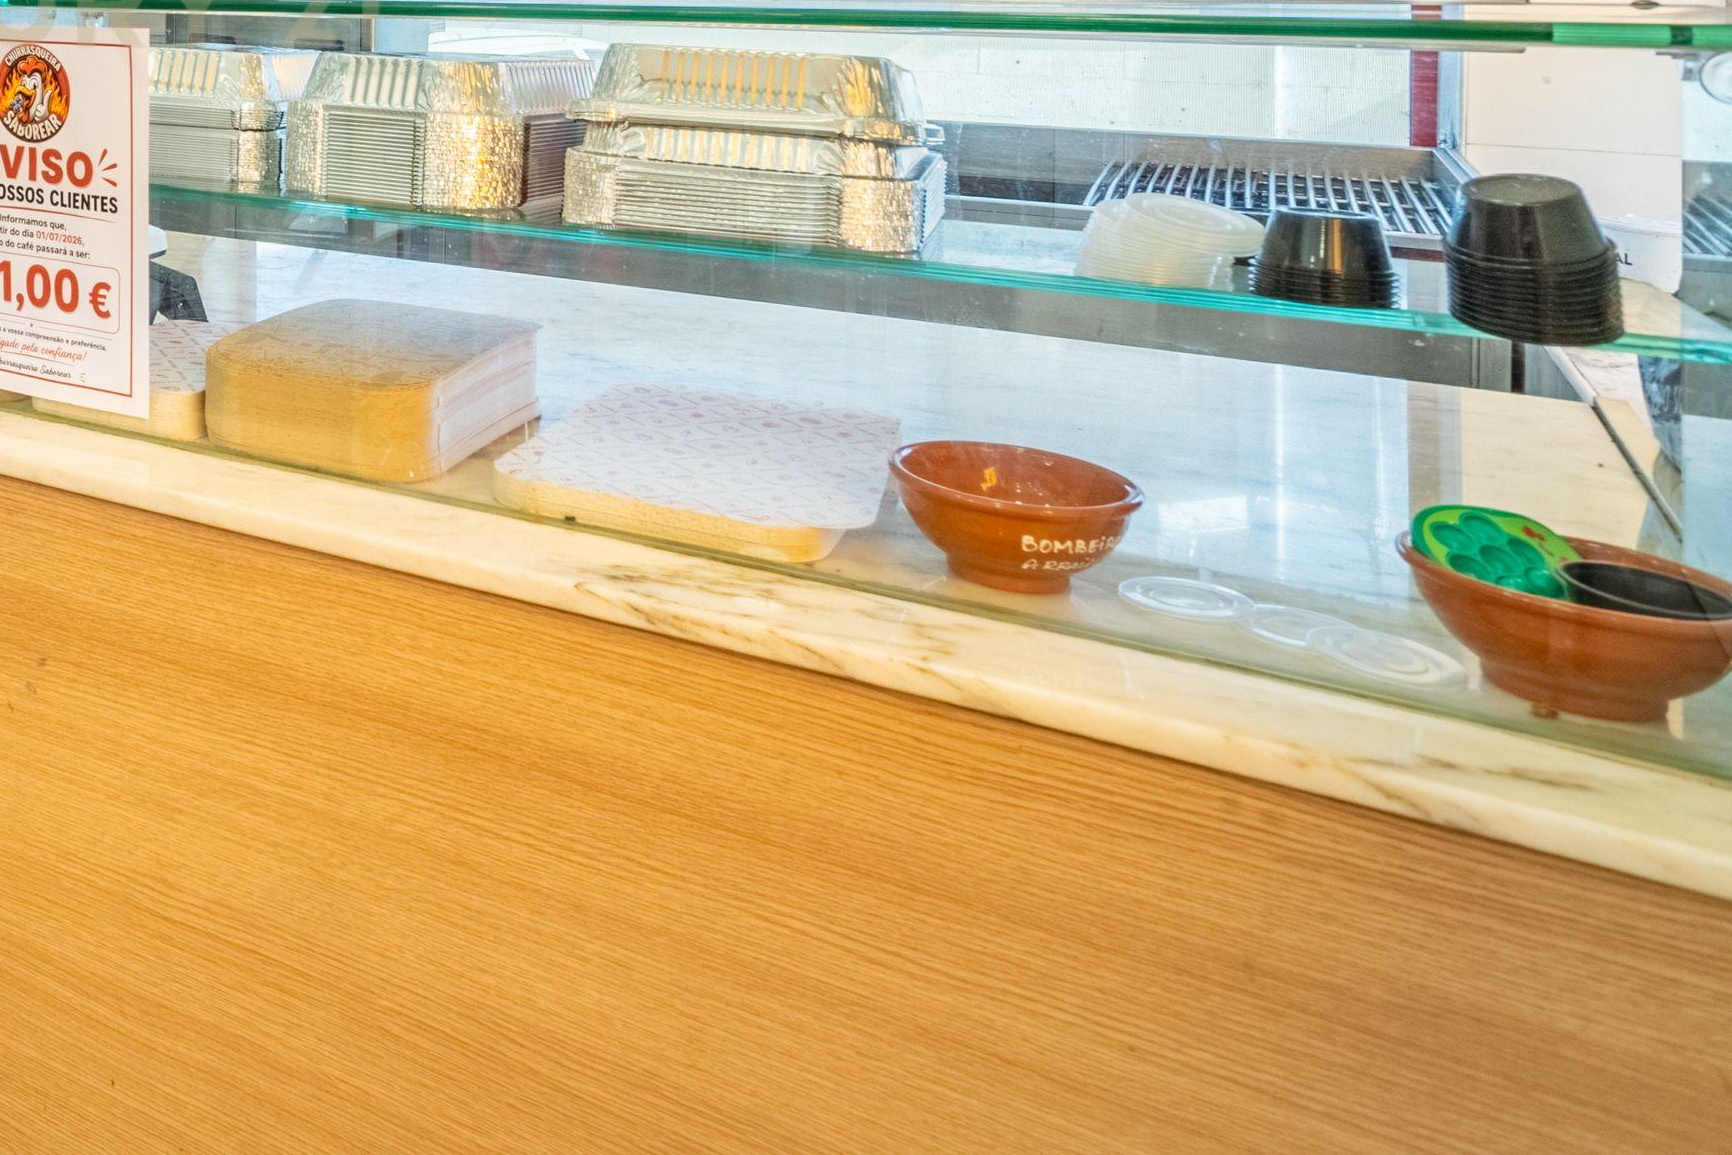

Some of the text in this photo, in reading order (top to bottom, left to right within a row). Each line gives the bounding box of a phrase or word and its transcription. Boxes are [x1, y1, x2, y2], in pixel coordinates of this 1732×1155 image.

[4, 45, 61, 72] CHURRASQUEIRA
[3, 111, 62, 141] SABOREAR
[50, 189, 118, 214] CLIENTES
[0, 213, 67, 232] Informamos que,
[10, 227, 20, 237] do
[21, 228, 34, 238] dia
[35, 231, 85, 246] 01/07/2026,
[5, 238, 15, 247] do
[17, 240, 34, 251] café
[36, 244, 68, 256] passará
[76, 251, 91, 260] ser:
[1614, 252, 1632, 266] AL
[88, 281, 112, 320] €
[7, 327, 24, 336] vossa
[25, 330, 64, 344] compreensão
[71, 338, 108, 352] preferência.
[21, 341, 38, 354] pela
[41, 345, 87, 361] confiança!
[39, 365, 72, 380] Saborear
